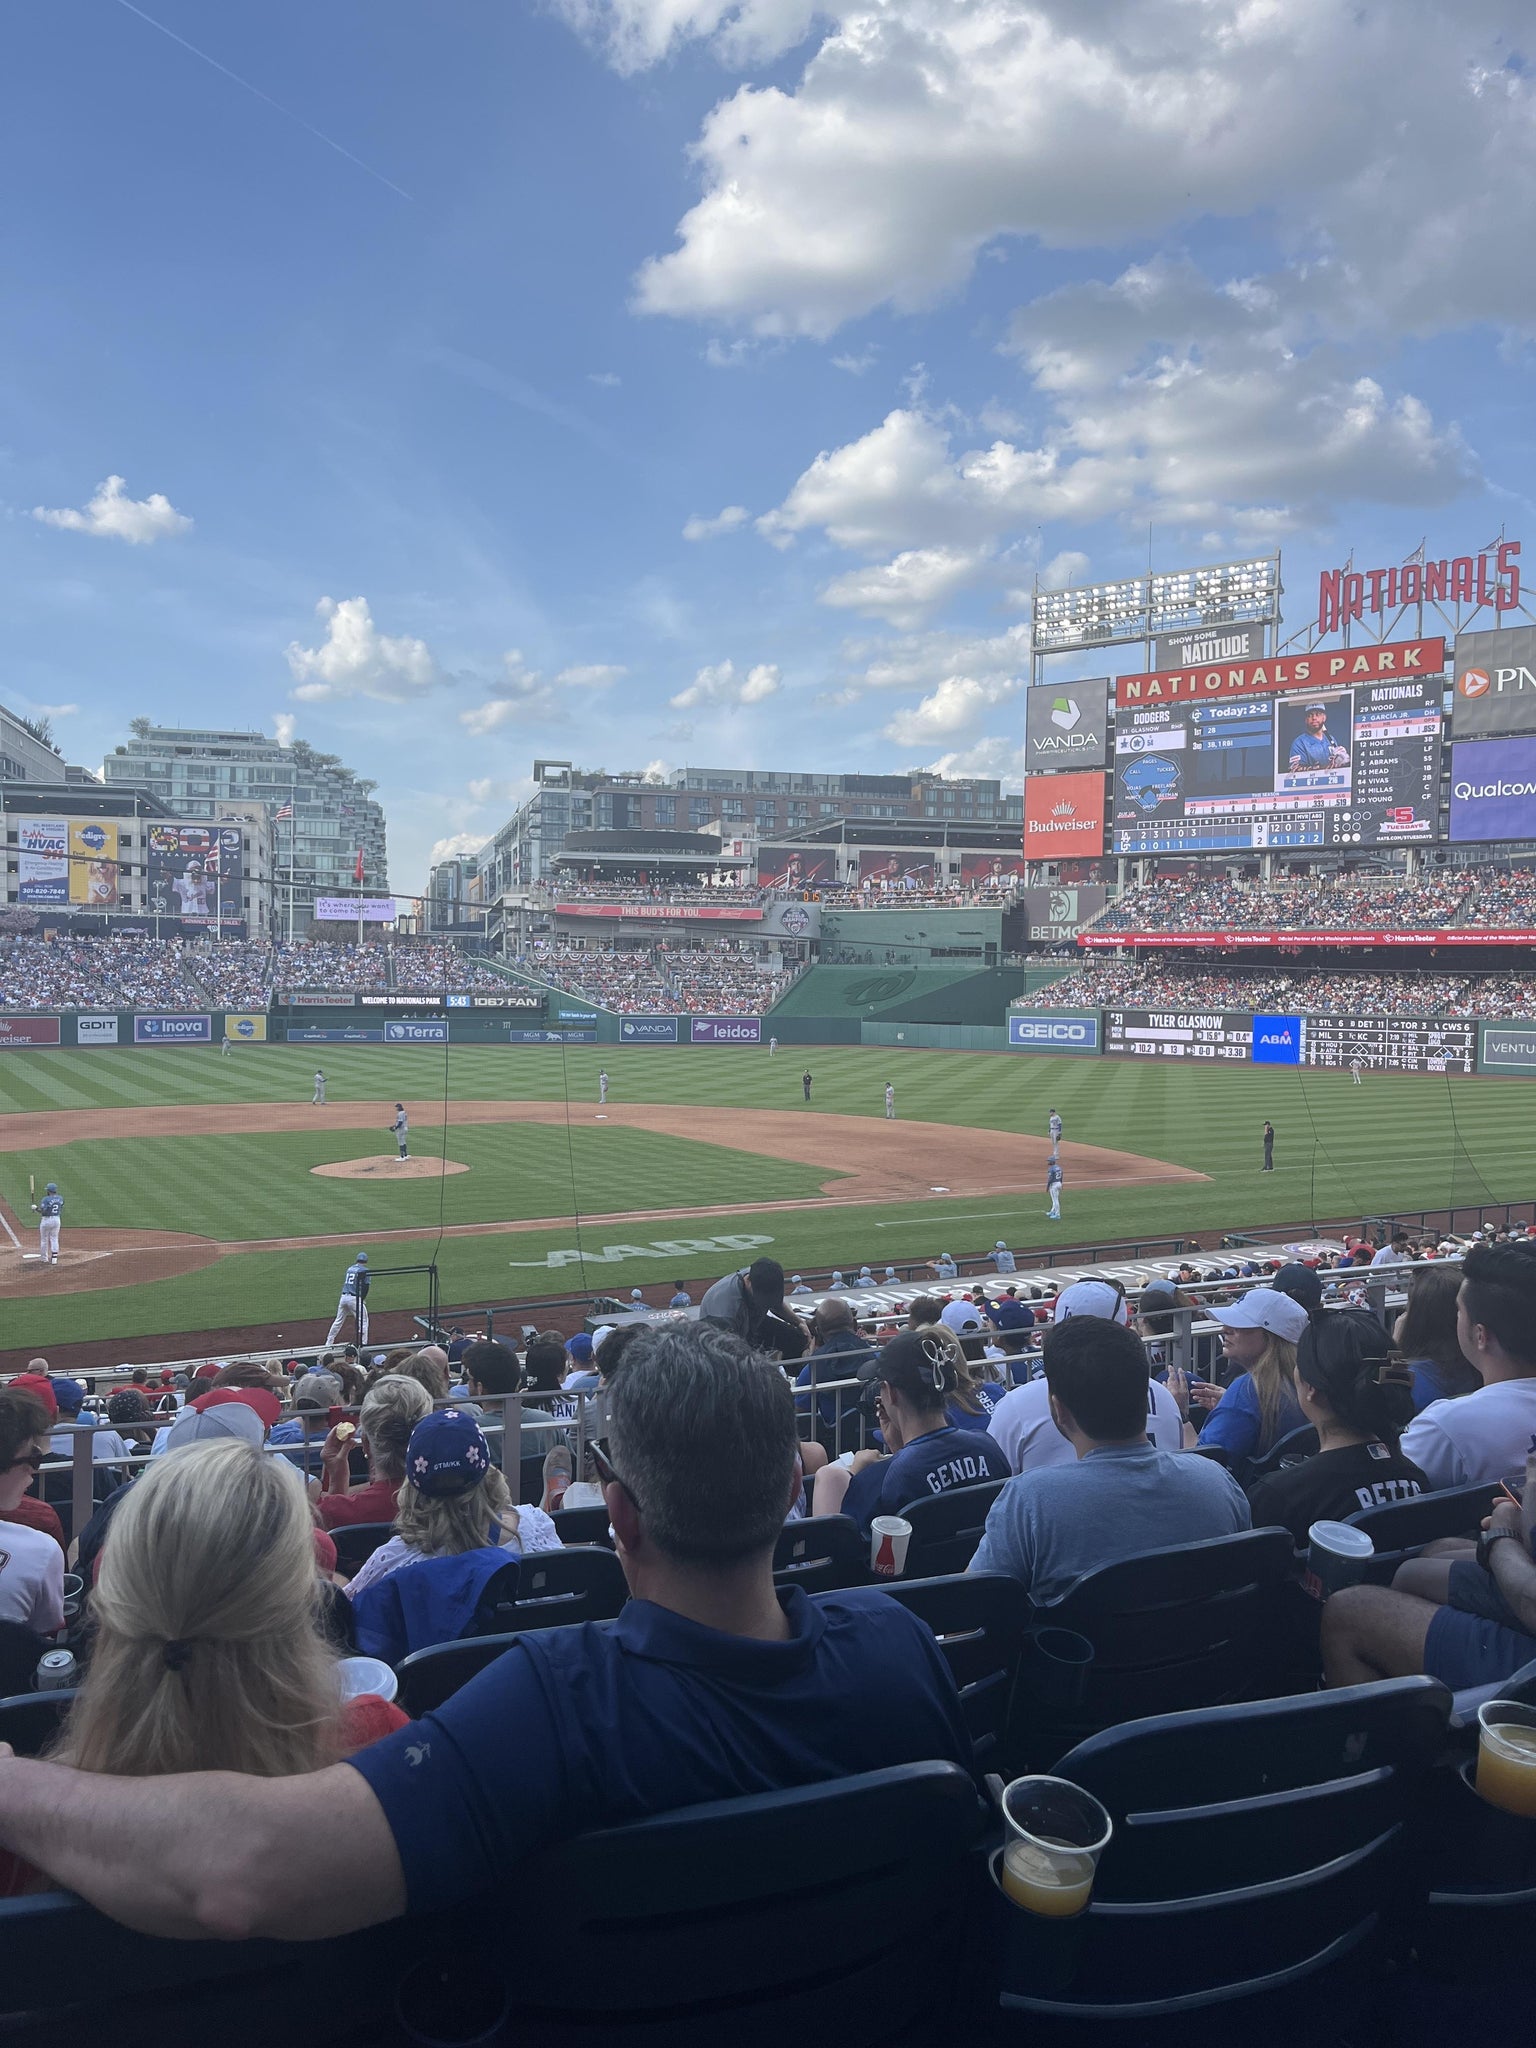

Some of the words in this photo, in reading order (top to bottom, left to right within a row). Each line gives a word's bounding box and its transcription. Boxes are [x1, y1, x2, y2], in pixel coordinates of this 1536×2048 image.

[1319, 541, 1521, 633] NATIONALS
[1168, 635, 1192, 646] SHOW
[1194, 631, 1217, 641] SOME
[1182, 633, 1249, 665] NATITUDE
[1127, 662, 1310, 698] NATIONALS
[1330, 648, 1422, 676] PARK
[1371, 684, 1423, 702] NATIONALS
[1210, 706, 1247, 718] Today:
[1249, 704, 1268, 714] 2-2
[1371, 704, 1394, 712] WOOD
[1134, 711, 1170, 724] DODGERS
[1131, 726, 1159, 734] GLASNOW
[1033, 733, 1099, 750] VANDA
[1369, 758, 1399, 766] ABRAMS
[1368, 796, 1392, 804] YOUNG
[1334, 814, 1340, 822] B
[1386, 806, 1413, 824] $5
[1028, 819, 1098, 833] Budweiser
[1334, 824, 1340, 832] S
[75, 831, 111, 841] Pedigree
[27, 840, 66, 849] HVAC
[812, 892, 820, 902] 15
[622, 907, 638, 915] THIS
[641, 907, 664, 915] BUD'S
[666, 908, 681, 916] FOR
[683, 908, 701, 917] YOU.
[297, 995, 324, 1004] Harris
[324, 996, 352, 1004] Teeter
[362, 996, 388, 1005] WELCOME
[389, 997, 395, 1005] TO
[396, 997, 425, 1005] NATIONALS
[426, 997, 441, 1005] PARK
[449, 996, 467, 1006] 5:43
[508, 998, 537, 1006] FAN
[1110, 1013, 1123, 1025] #31
[1148, 1014, 1176, 1028] TYLER
[1177, 1015, 1223, 1029] GLASNOW
[80, 1021, 116, 1030] GDIT
[162, 1020, 202, 1033] Inova
[714, 1024, 758, 1038] leidos
[1019, 1023, 1086, 1040] GEICO
[1401, 1021, 1418, 1030] TOR
[1421, 1022, 1427, 1030] 3
[1442, 1023, 1462, 1031] CWS
[1464, 1023, 1470, 1031] 6
[406, 1026, 443, 1038] Terra
[1260, 1034, 1292, 1045] ABM
[1139, 1044, 1152, 1053] 10.2
[1170, 1046, 1178, 1054] 13
[1199, 1047, 1211, 1055] 0-0
[1227, 1048, 1243, 1057] 3.38
[52, 1204, 58, 1214] 2
[509, 1234, 775, 1268] AARP
[345, 1272, 356, 1284] 12
[789, 1275, 1063, 1316] ASHINGTON
[926, 1456, 990, 1494] GENDA
